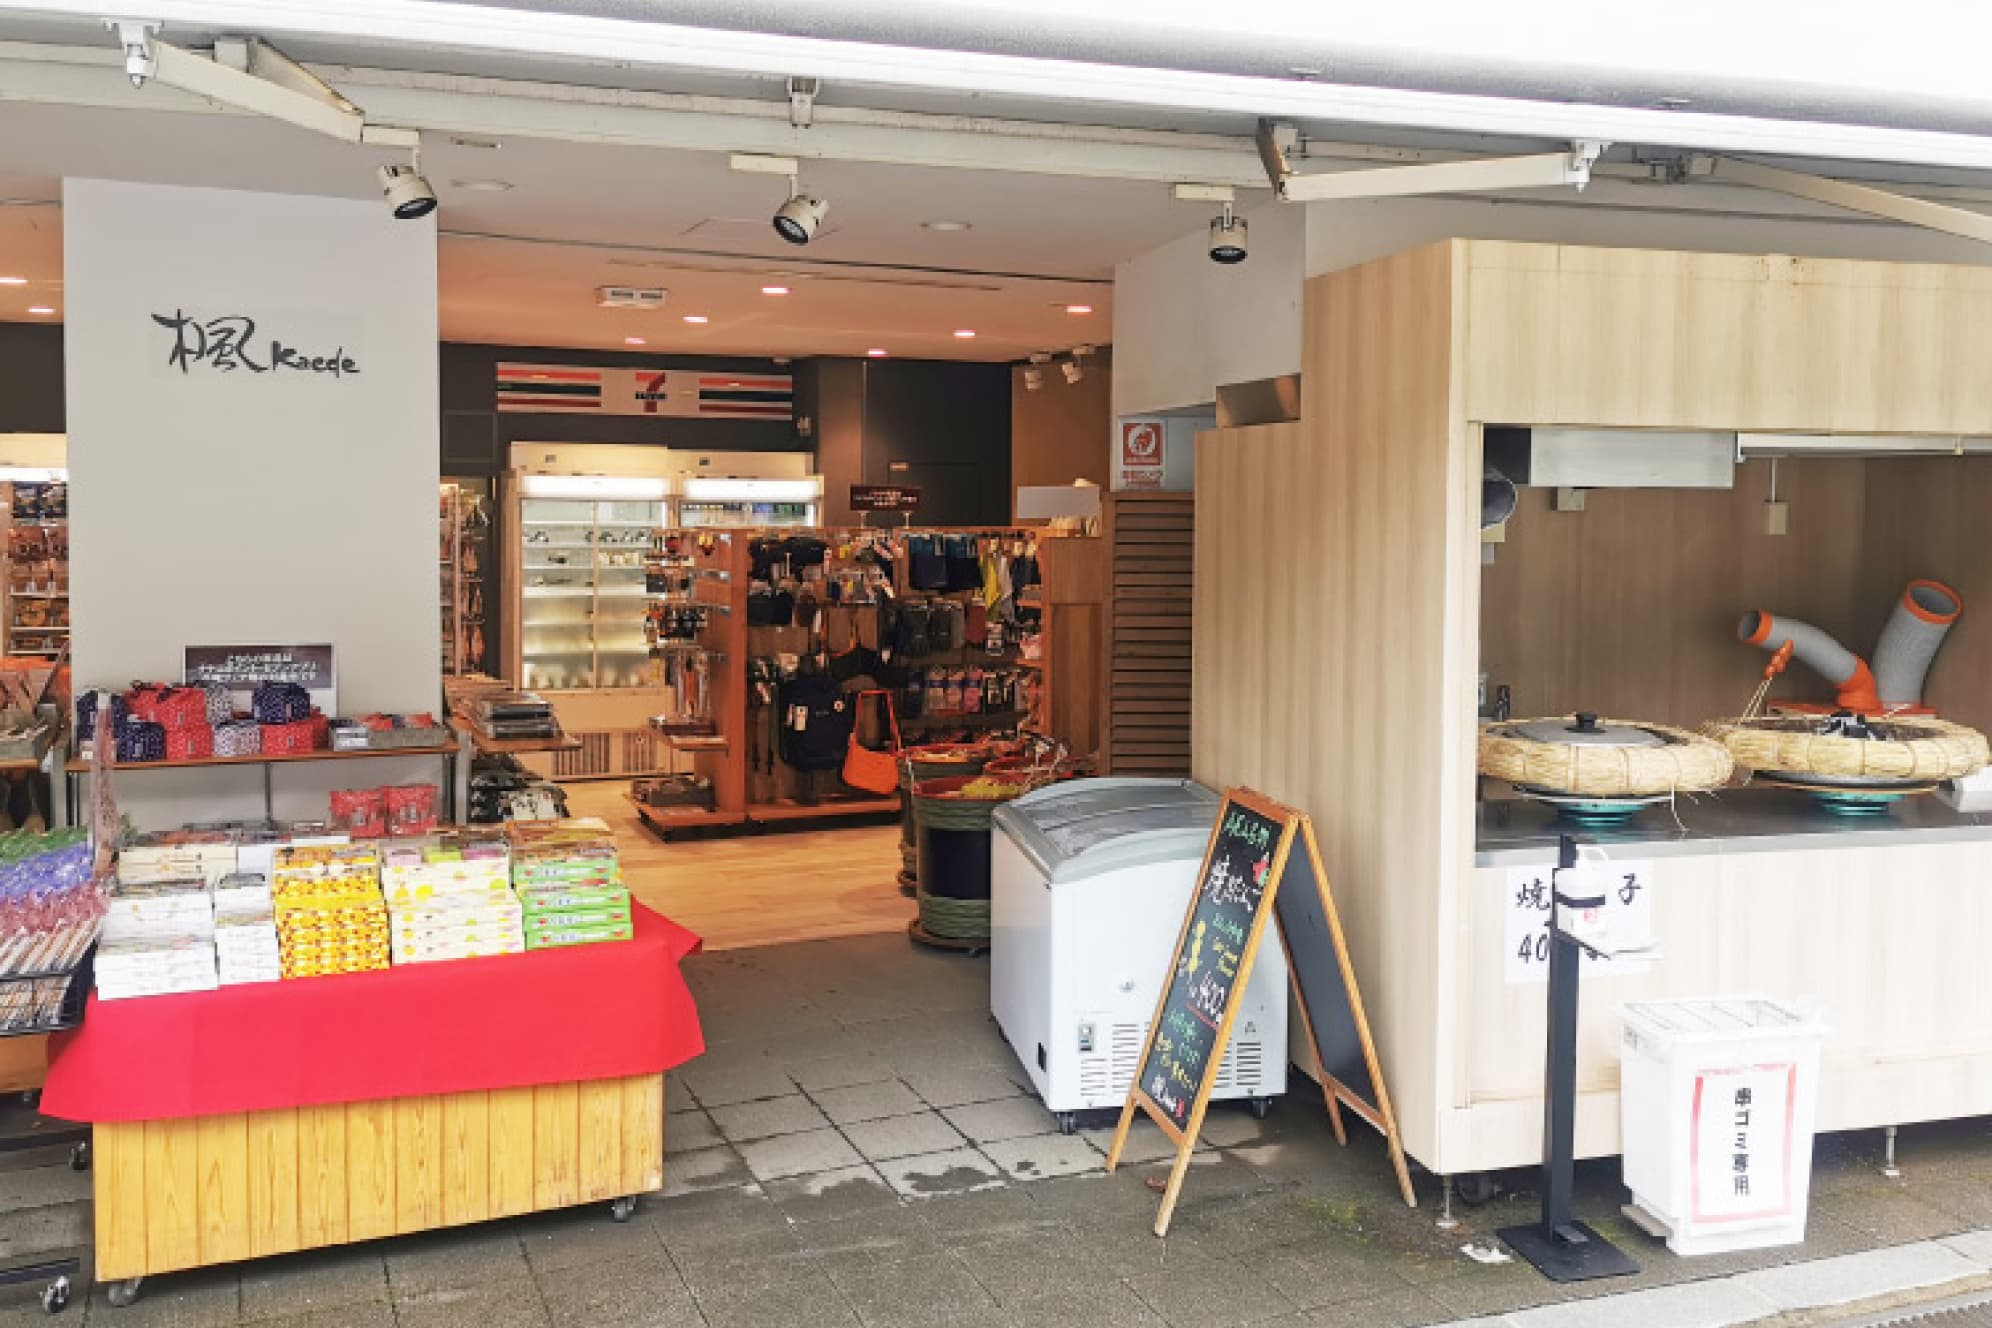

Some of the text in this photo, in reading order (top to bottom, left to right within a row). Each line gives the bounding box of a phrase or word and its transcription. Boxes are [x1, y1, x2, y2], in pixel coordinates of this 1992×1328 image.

[271, 340, 360, 378] Kaede
[1731, 1087, 1752, 1197] 串ゴミ専用
